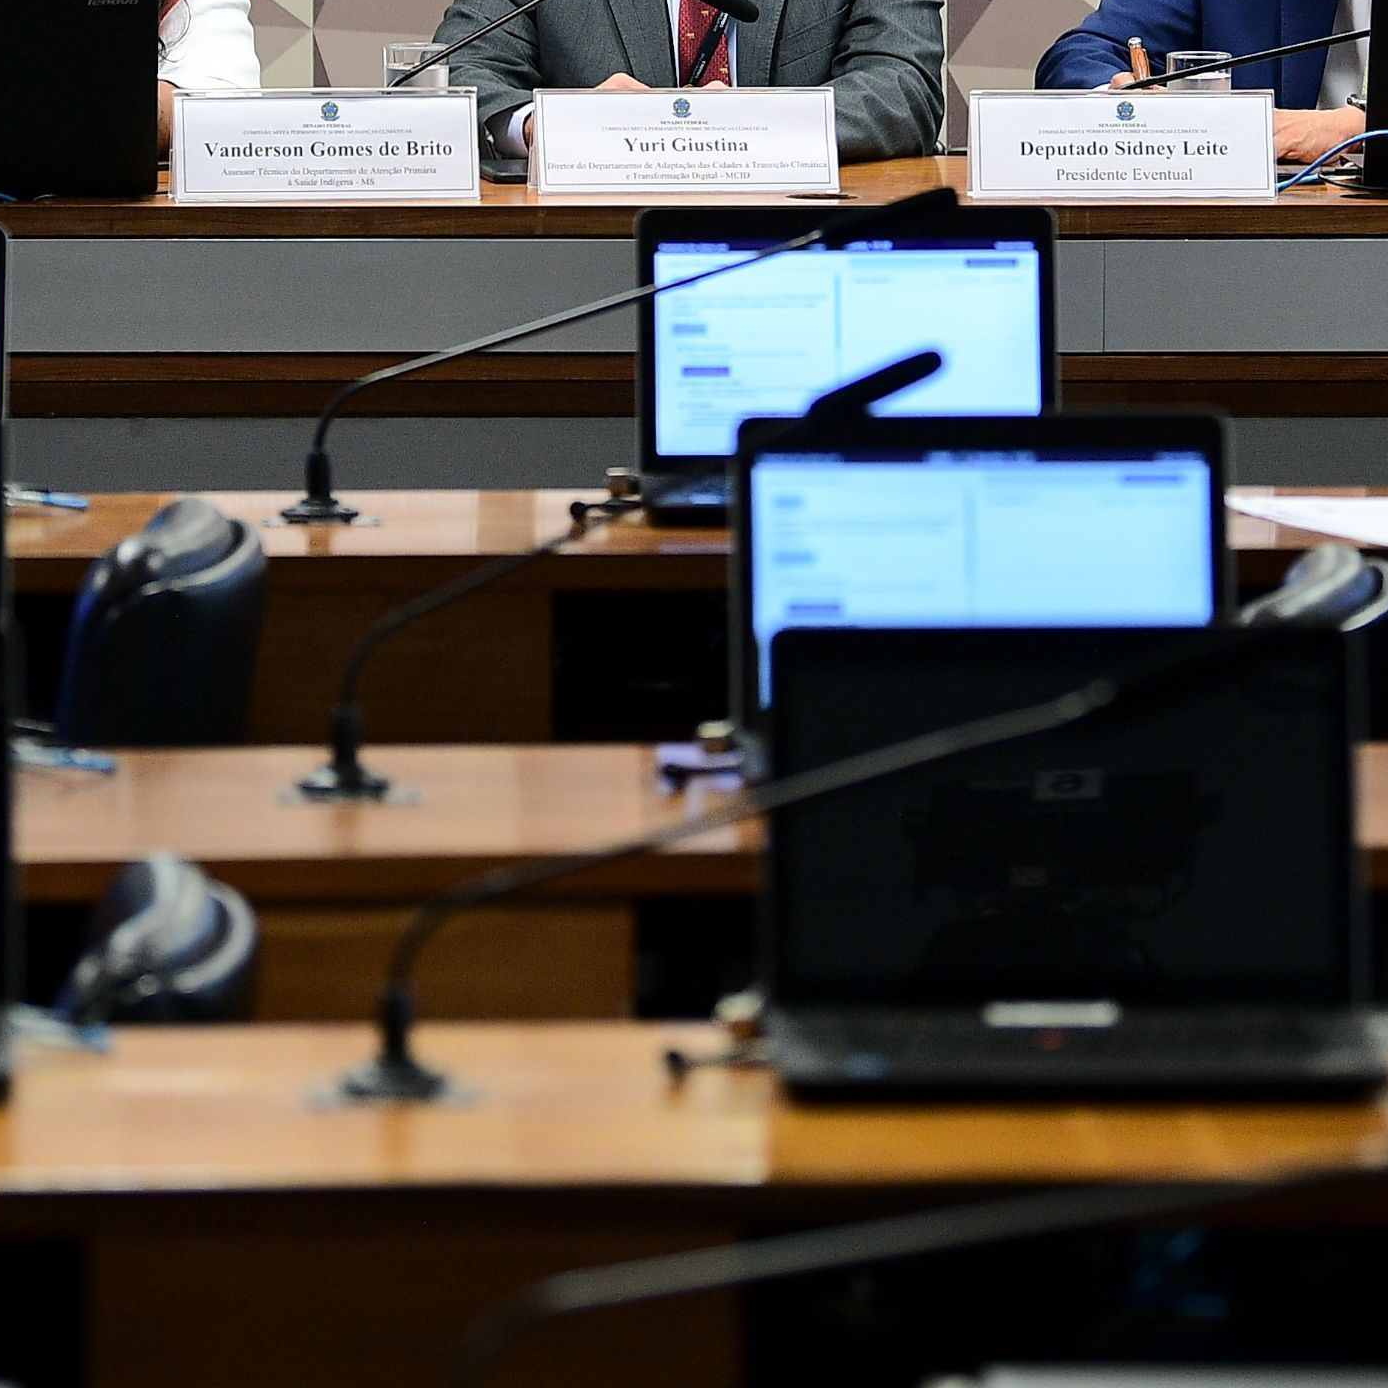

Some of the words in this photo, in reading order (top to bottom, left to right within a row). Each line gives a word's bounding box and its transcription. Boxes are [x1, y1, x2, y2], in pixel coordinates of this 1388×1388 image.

[204, 142, 304, 158] Vanderson
[310, 141, 373, 158] Gomes
[378, 141, 400, 157] de
[406, 140, 453, 156] Brito
[623, 137, 666, 153] Yuri
[671, 137, 749, 152] Giustina
[1020, 140, 1109, 161] Deputado
[1114, 140, 1176, 160] Sidney
[1183, 140, 1229, 156] Leite
[220, 168, 256, 176] Assessor
[256, 167, 289, 178] Técnico
[289, 167, 301, 176] do
[302, 167, 357, 177] Departamento
[357, 166, 368, 175] de
[369, 166, 403, 176] Atenção
[547, 161, 575, 171] Diretor
[576, 161, 587, 170] do
[588, 161, 643, 171] Departamento
[643, 161, 653, 170] de
[655, 161, 696, 171] Adaptação
[697, 161, 711, 169] das
[711, 161, 743, 169] Cidades
[750, 161, 790, 170] Transição
[632, 171, 690, 181] Transformação
[691, 171, 718, 181] Digital
[725, 171, 751, 180] MCID
[1056, 167, 1128, 181] Presidente
[1132, 167, 1193, 181] Eventual
[294, 177, 319, 187] Saúde
[318, 177, 354, 188] Indígena
[360, 177, 375, 186] MS
